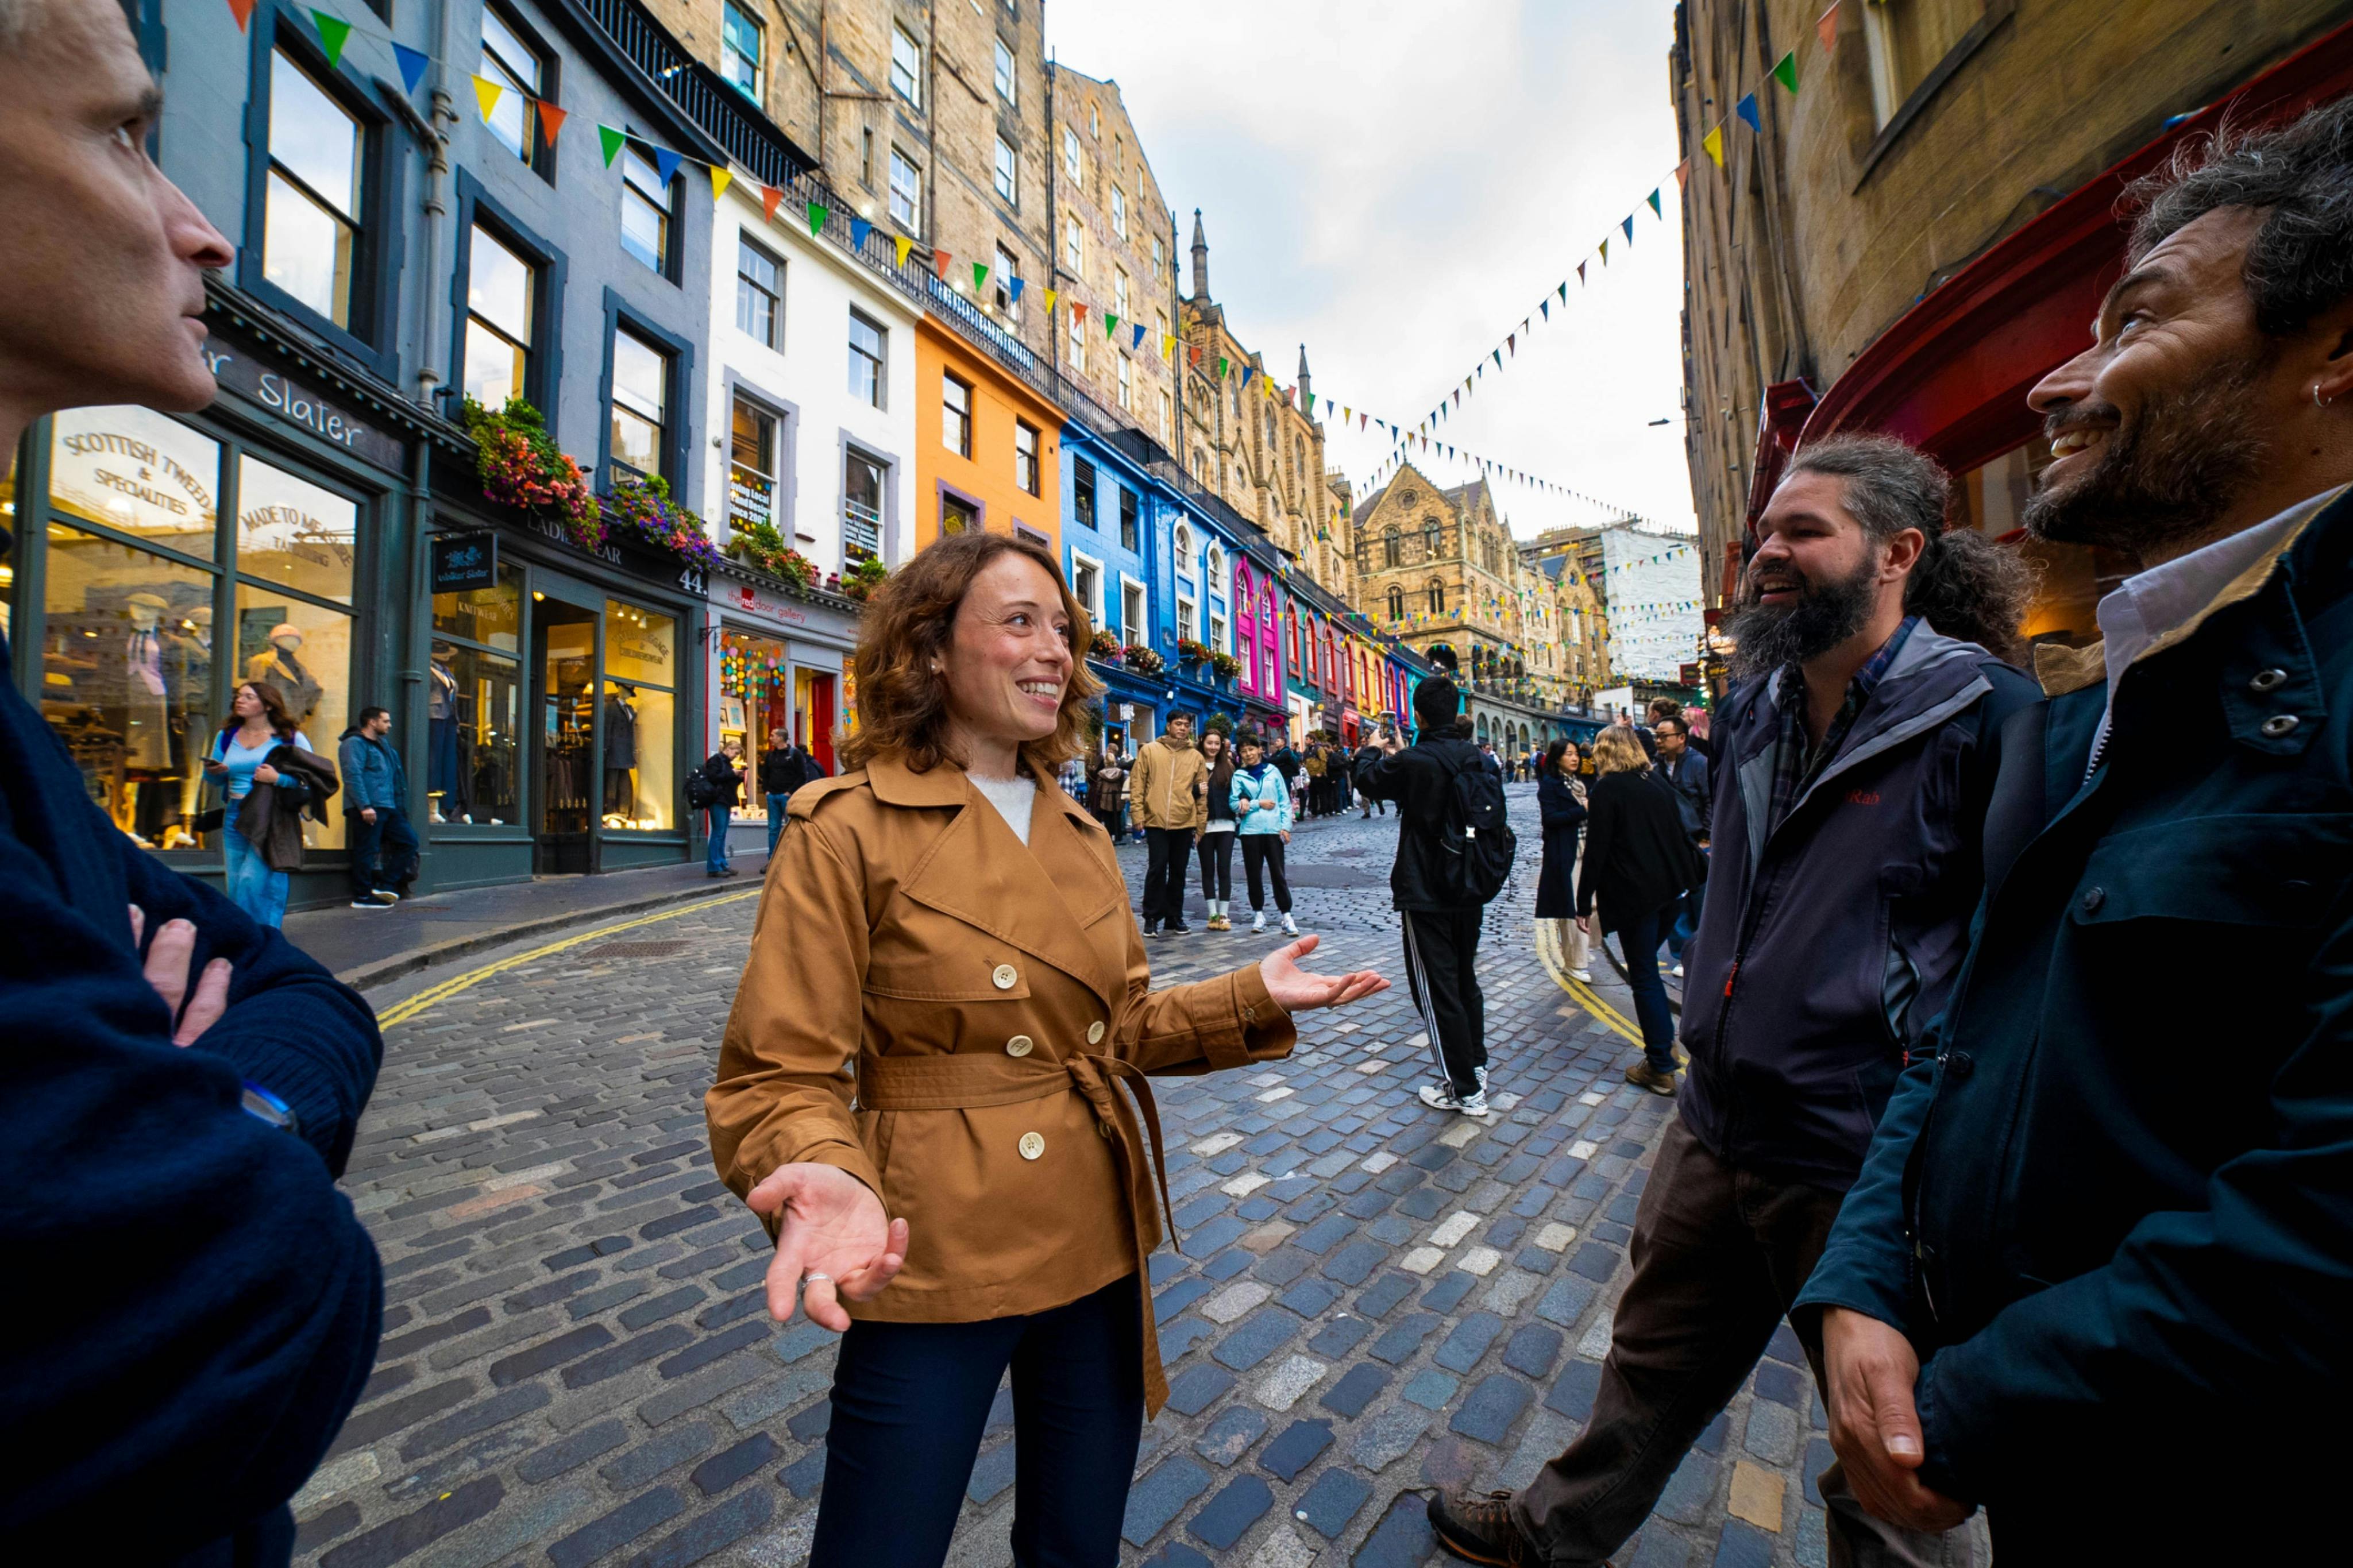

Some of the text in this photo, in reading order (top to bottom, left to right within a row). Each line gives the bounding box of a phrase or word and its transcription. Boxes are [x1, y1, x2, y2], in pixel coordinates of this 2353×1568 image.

[259, 373, 362, 447] Slater
[63, 432, 213, 509] SCOTTISH TWEED
[95, 467, 188, 516] SPECIALITIES
[137, 467, 152, 481] &
[751, 489, 770, 505] Local
[240, 506, 353, 567] MADE TO MERE
[527, 512, 622, 565] LADIEAR
[458, 601, 497, 621] KNITWEAR
[728, 589, 805, 624] the red door gallery
